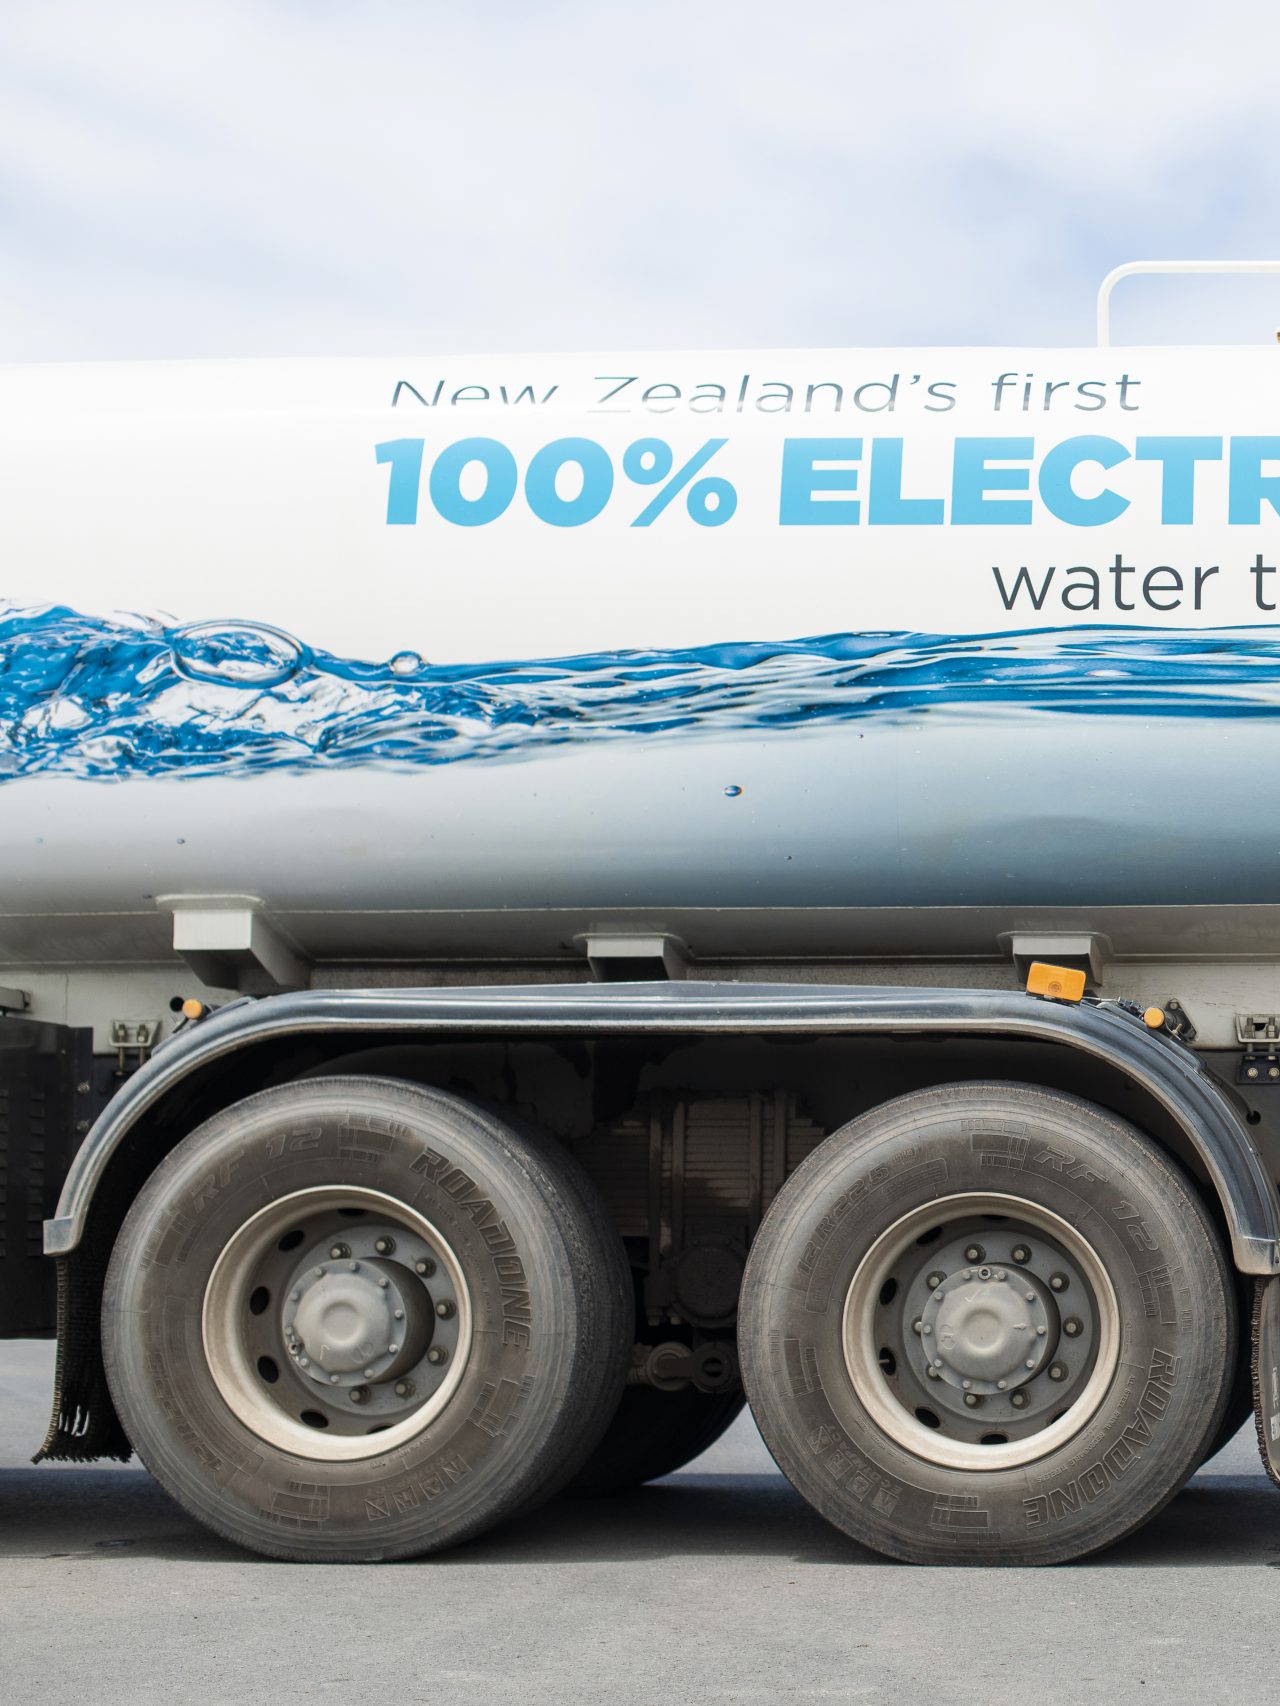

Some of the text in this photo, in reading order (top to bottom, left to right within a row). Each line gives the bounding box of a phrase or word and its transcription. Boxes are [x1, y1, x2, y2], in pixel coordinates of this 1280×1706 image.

[391, 379, 560, 410] New
[991, 373, 1142, 412] first
[374, 436, 738, 528] 100%
[991, 553, 1220, 612] water
[265, 1127, 323, 1159] 12
[1033, 1146, 1159, 1252] RF 12
[408, 1146, 533, 1351] ROADONE
[1022, 1347, 1183, 1529] ROADONE
